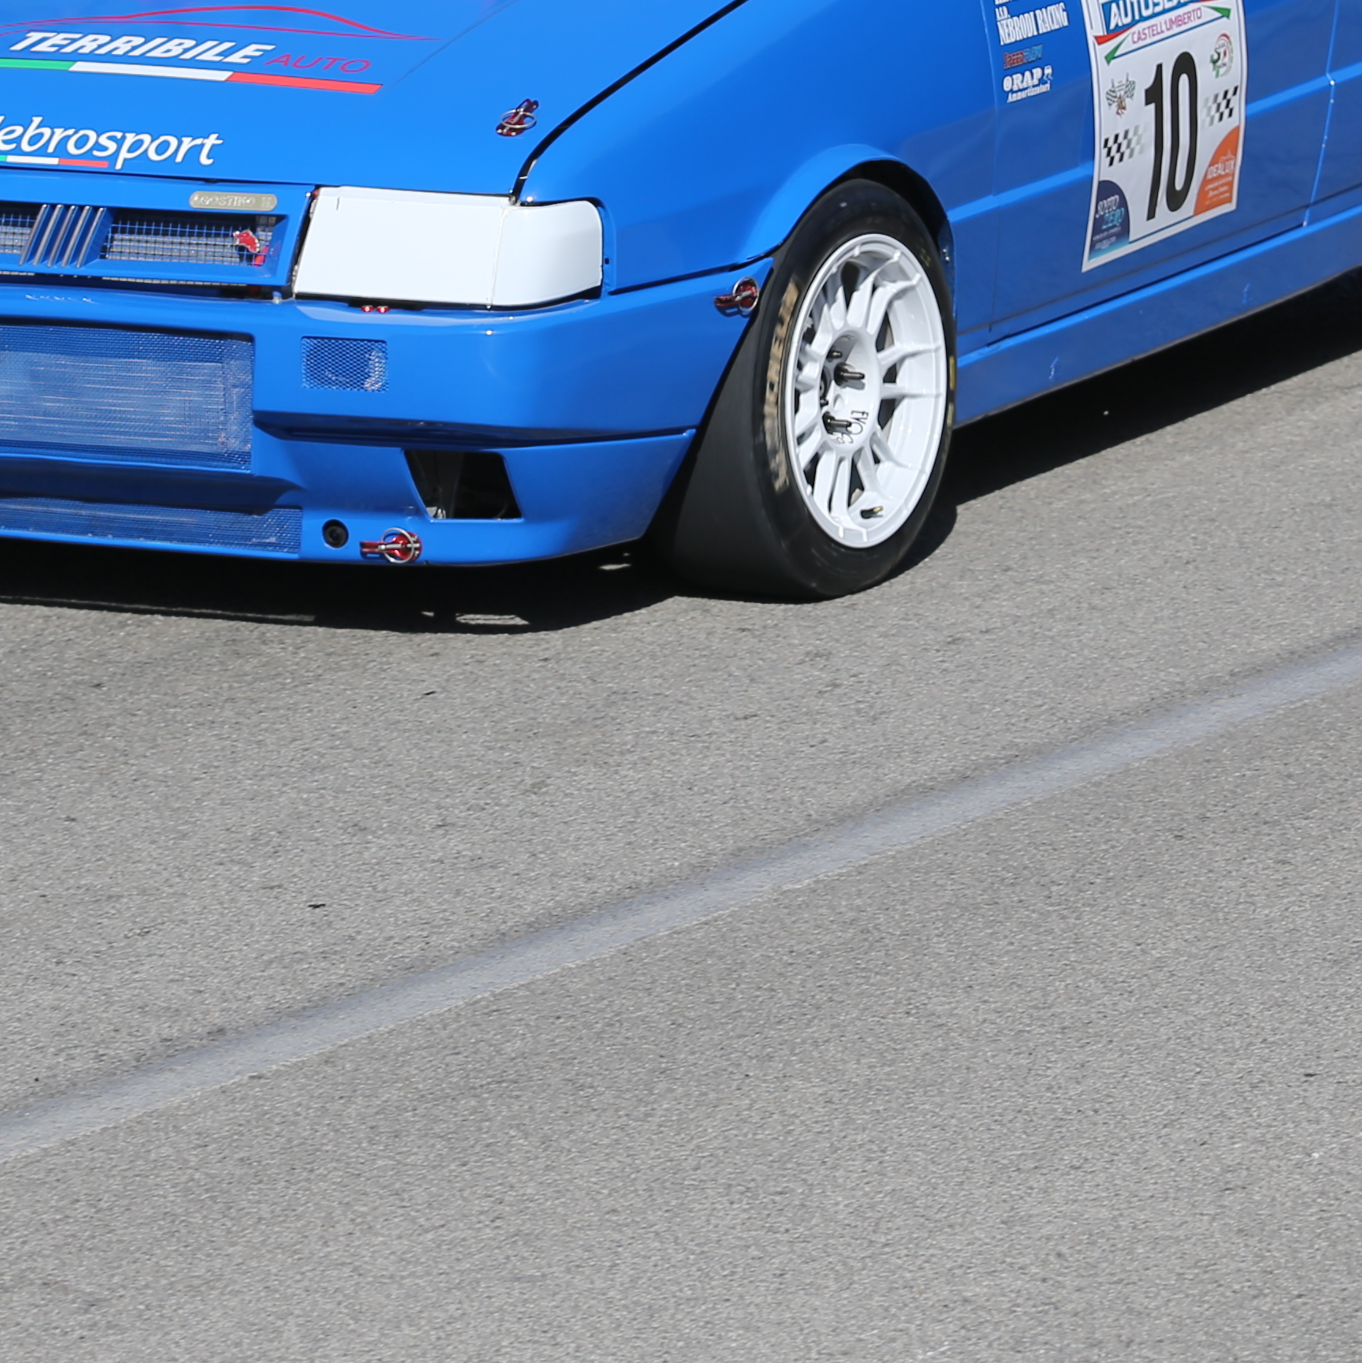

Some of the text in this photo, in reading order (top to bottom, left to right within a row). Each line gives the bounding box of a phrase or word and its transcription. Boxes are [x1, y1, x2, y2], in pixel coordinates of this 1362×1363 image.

[997, 2, 1069, 45] NEBRODI RACING
[9, 30, 372, 74] TERRIBILE AUTO
[1003, 66, 1043, 93] ORAP
[1144, 51, 1198, 222] 10
